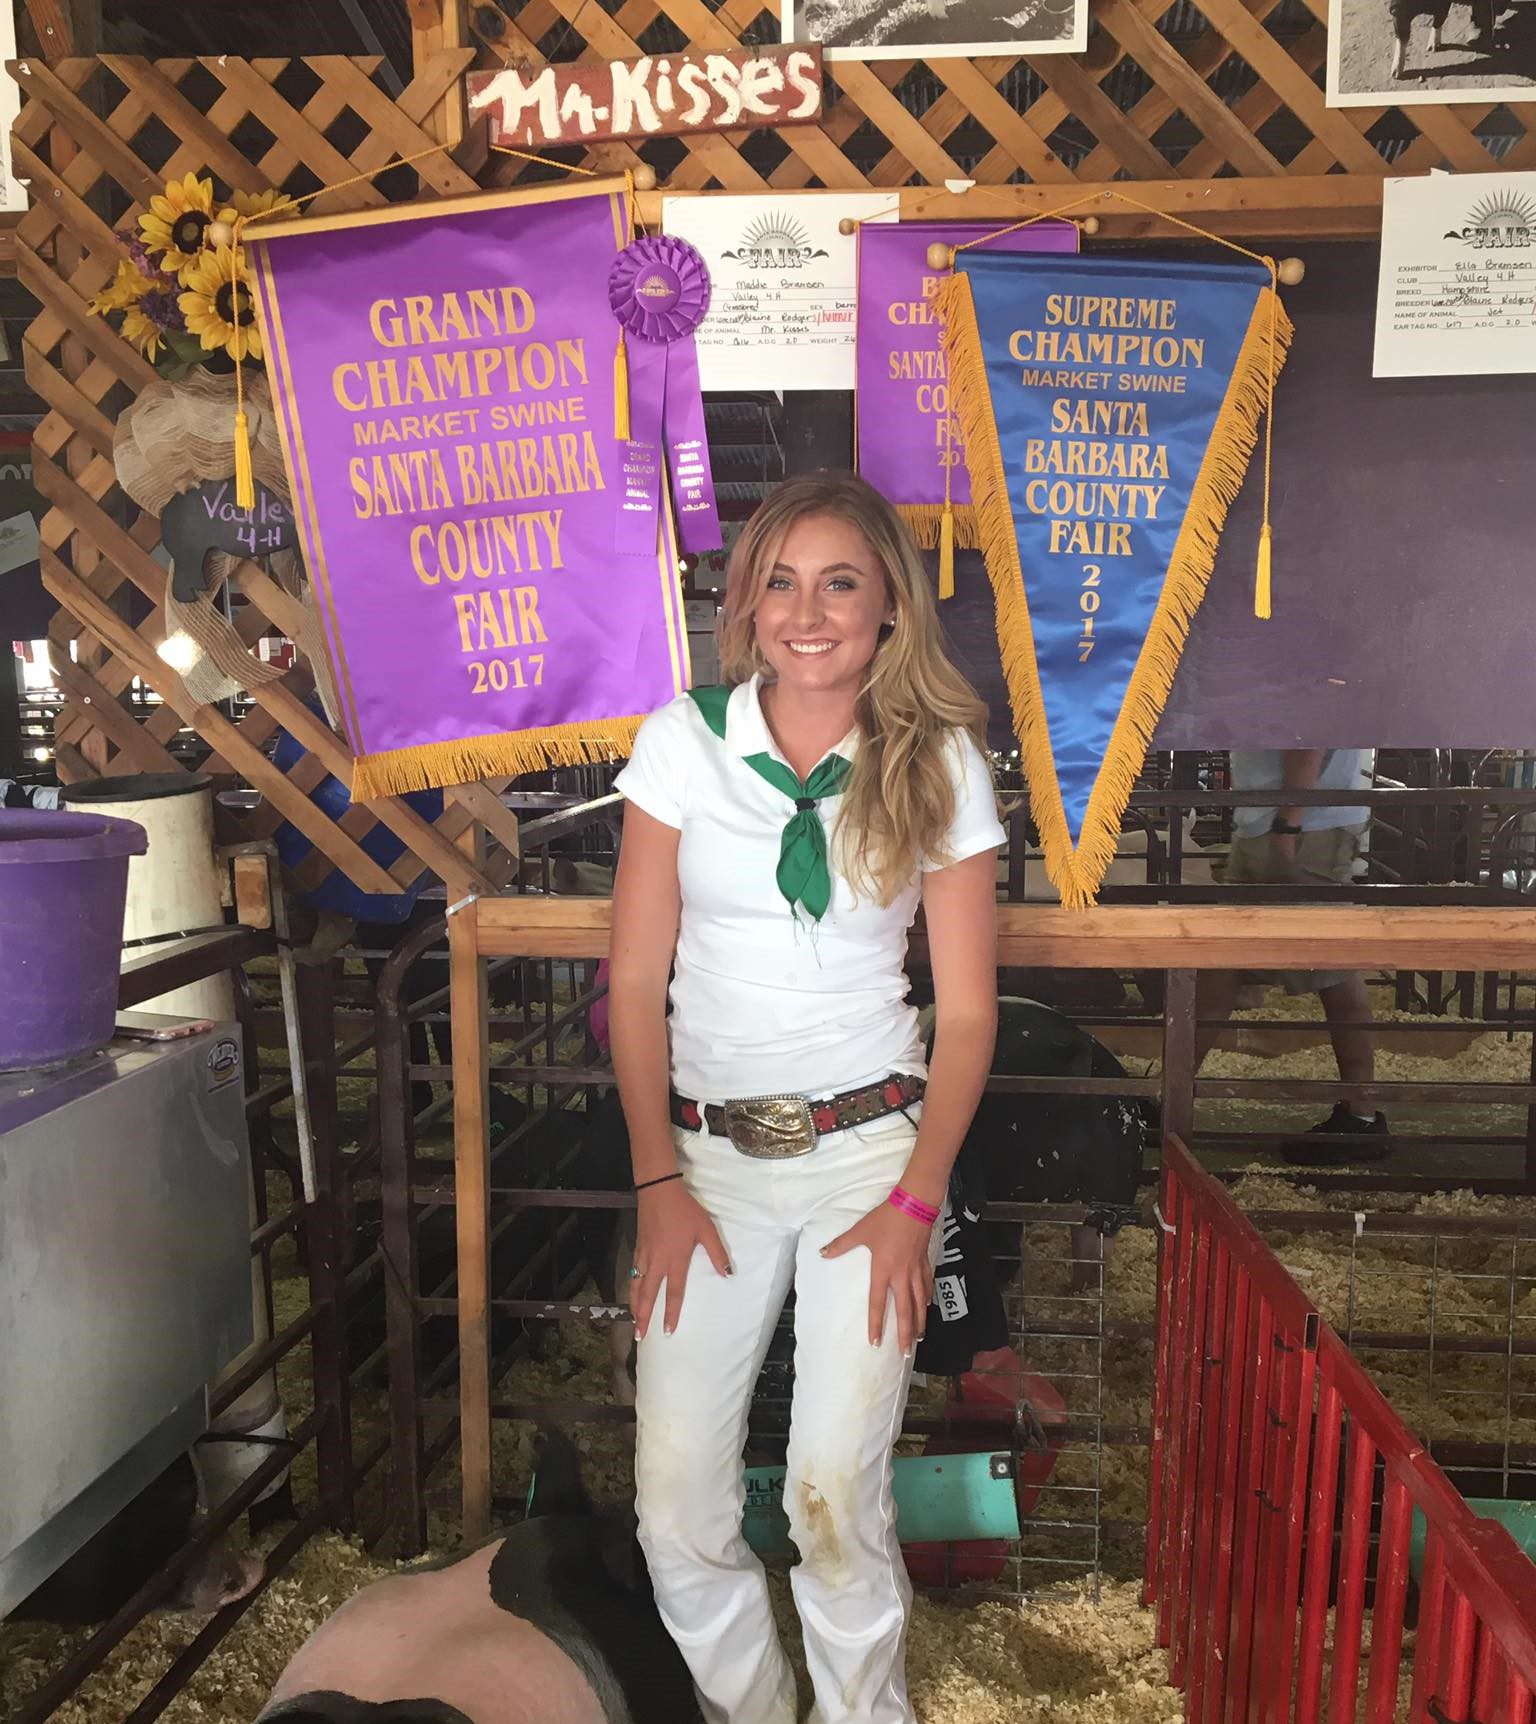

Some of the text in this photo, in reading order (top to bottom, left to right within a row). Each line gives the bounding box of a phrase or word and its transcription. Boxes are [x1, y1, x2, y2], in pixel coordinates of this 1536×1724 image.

[1473, 227, 1531, 249] FAIR
[748, 248, 803, 269] FAIR
[731, 291, 759, 306] Valley
[1456, 272, 1489, 286] Valley
[369, 287, 535, 348] GRAND
[1045, 294, 1177, 330] SUPREME
[889, 351, 947, 379] SANTA
[1008, 330, 1205, 369] CHAMPION
[332, 338, 589, 412] CHAMPION
[1023, 368, 1187, 393] MARKET SWINE
[353, 397, 587, 446] MARKET SWINE
[1051, 398, 1150, 437] SANTA
[350, 431, 606, 519] SANTA BARBARA
[1024, 439, 1170, 479] BARBARA
[1026, 479, 1166, 519] COUNTY
[237, 526, 281, 553] 4-H
[410, 509, 564, 585] COUNTY
[1049, 519, 1133, 556] FAIR
[453, 586, 548, 652] FAIR
[467, 654, 544, 694] 2017
[939, 1281, 960, 1318] 1985
